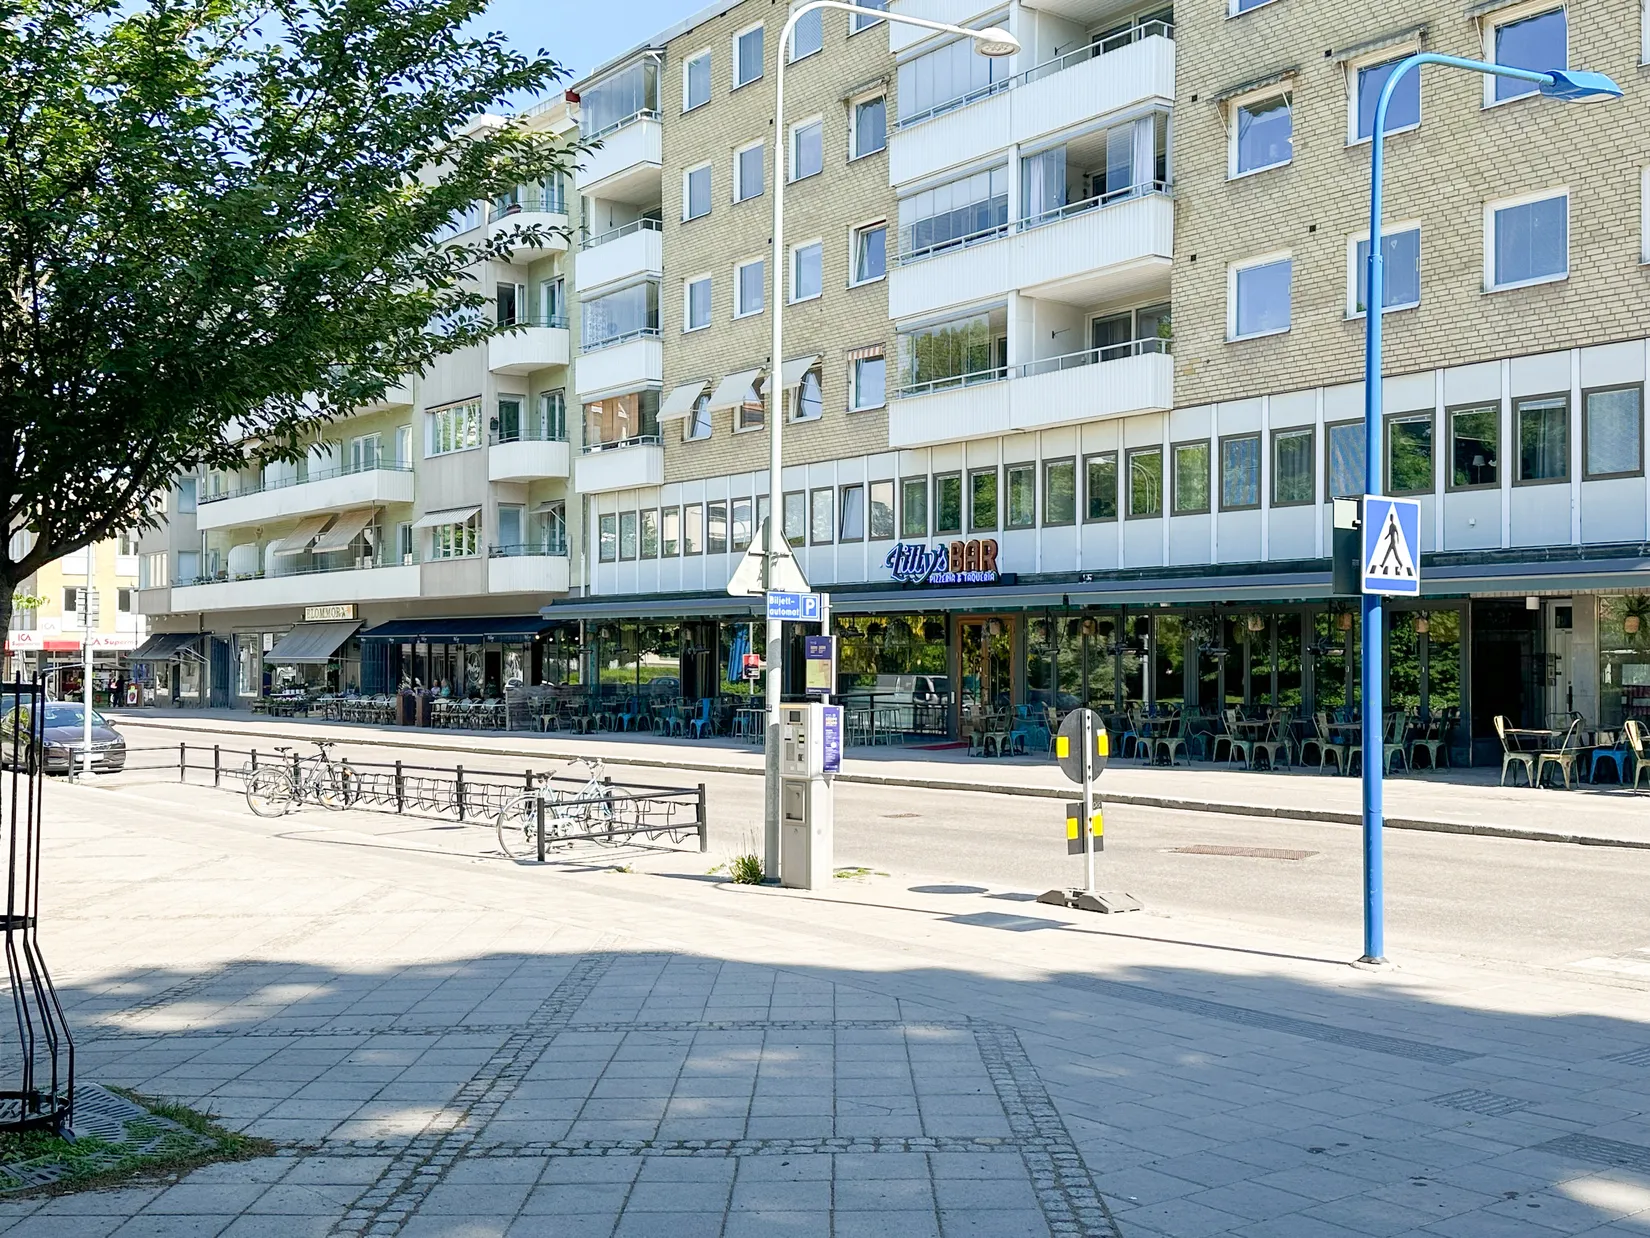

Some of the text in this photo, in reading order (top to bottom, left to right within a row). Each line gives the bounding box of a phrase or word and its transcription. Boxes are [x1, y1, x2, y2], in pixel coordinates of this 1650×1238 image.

[885, 539, 998, 584] Lilly's BAR
[929, 571, 995, 584] PIZZERIA & TAQUERIA
[769, 595, 795, 607] Biljett-
[805, 598, 815, 615] P
[769, 607, 800, 616] automat
[17, 633, 32, 642] ICA
